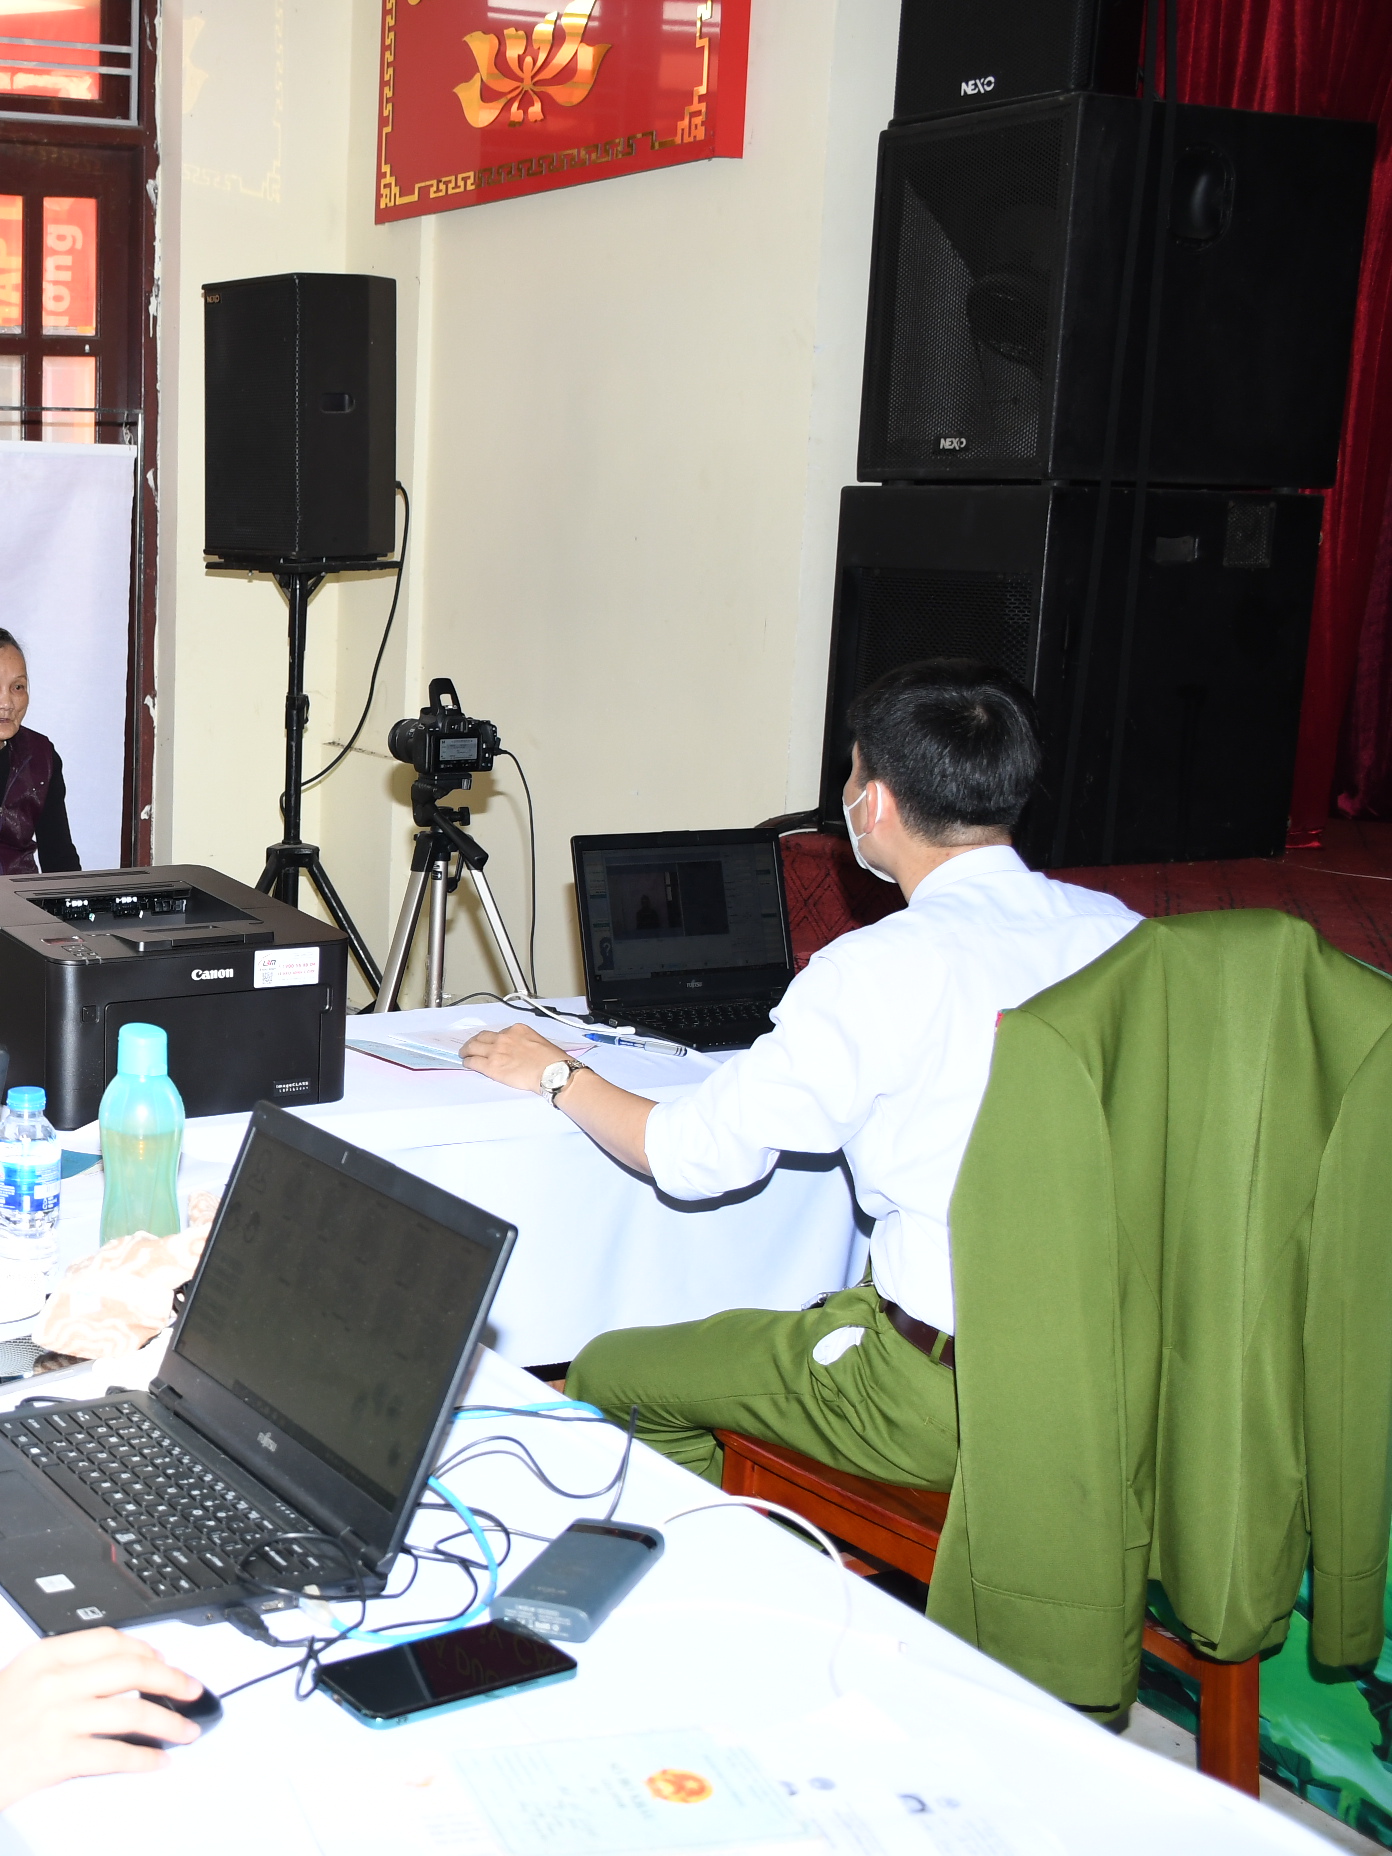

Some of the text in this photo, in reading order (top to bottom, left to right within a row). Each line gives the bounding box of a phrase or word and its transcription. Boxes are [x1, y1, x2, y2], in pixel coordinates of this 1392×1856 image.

[960, 76, 995, 96] NEXO
[939, 437, 967, 450] NEXO
[191, 968, 234, 981] Canon
